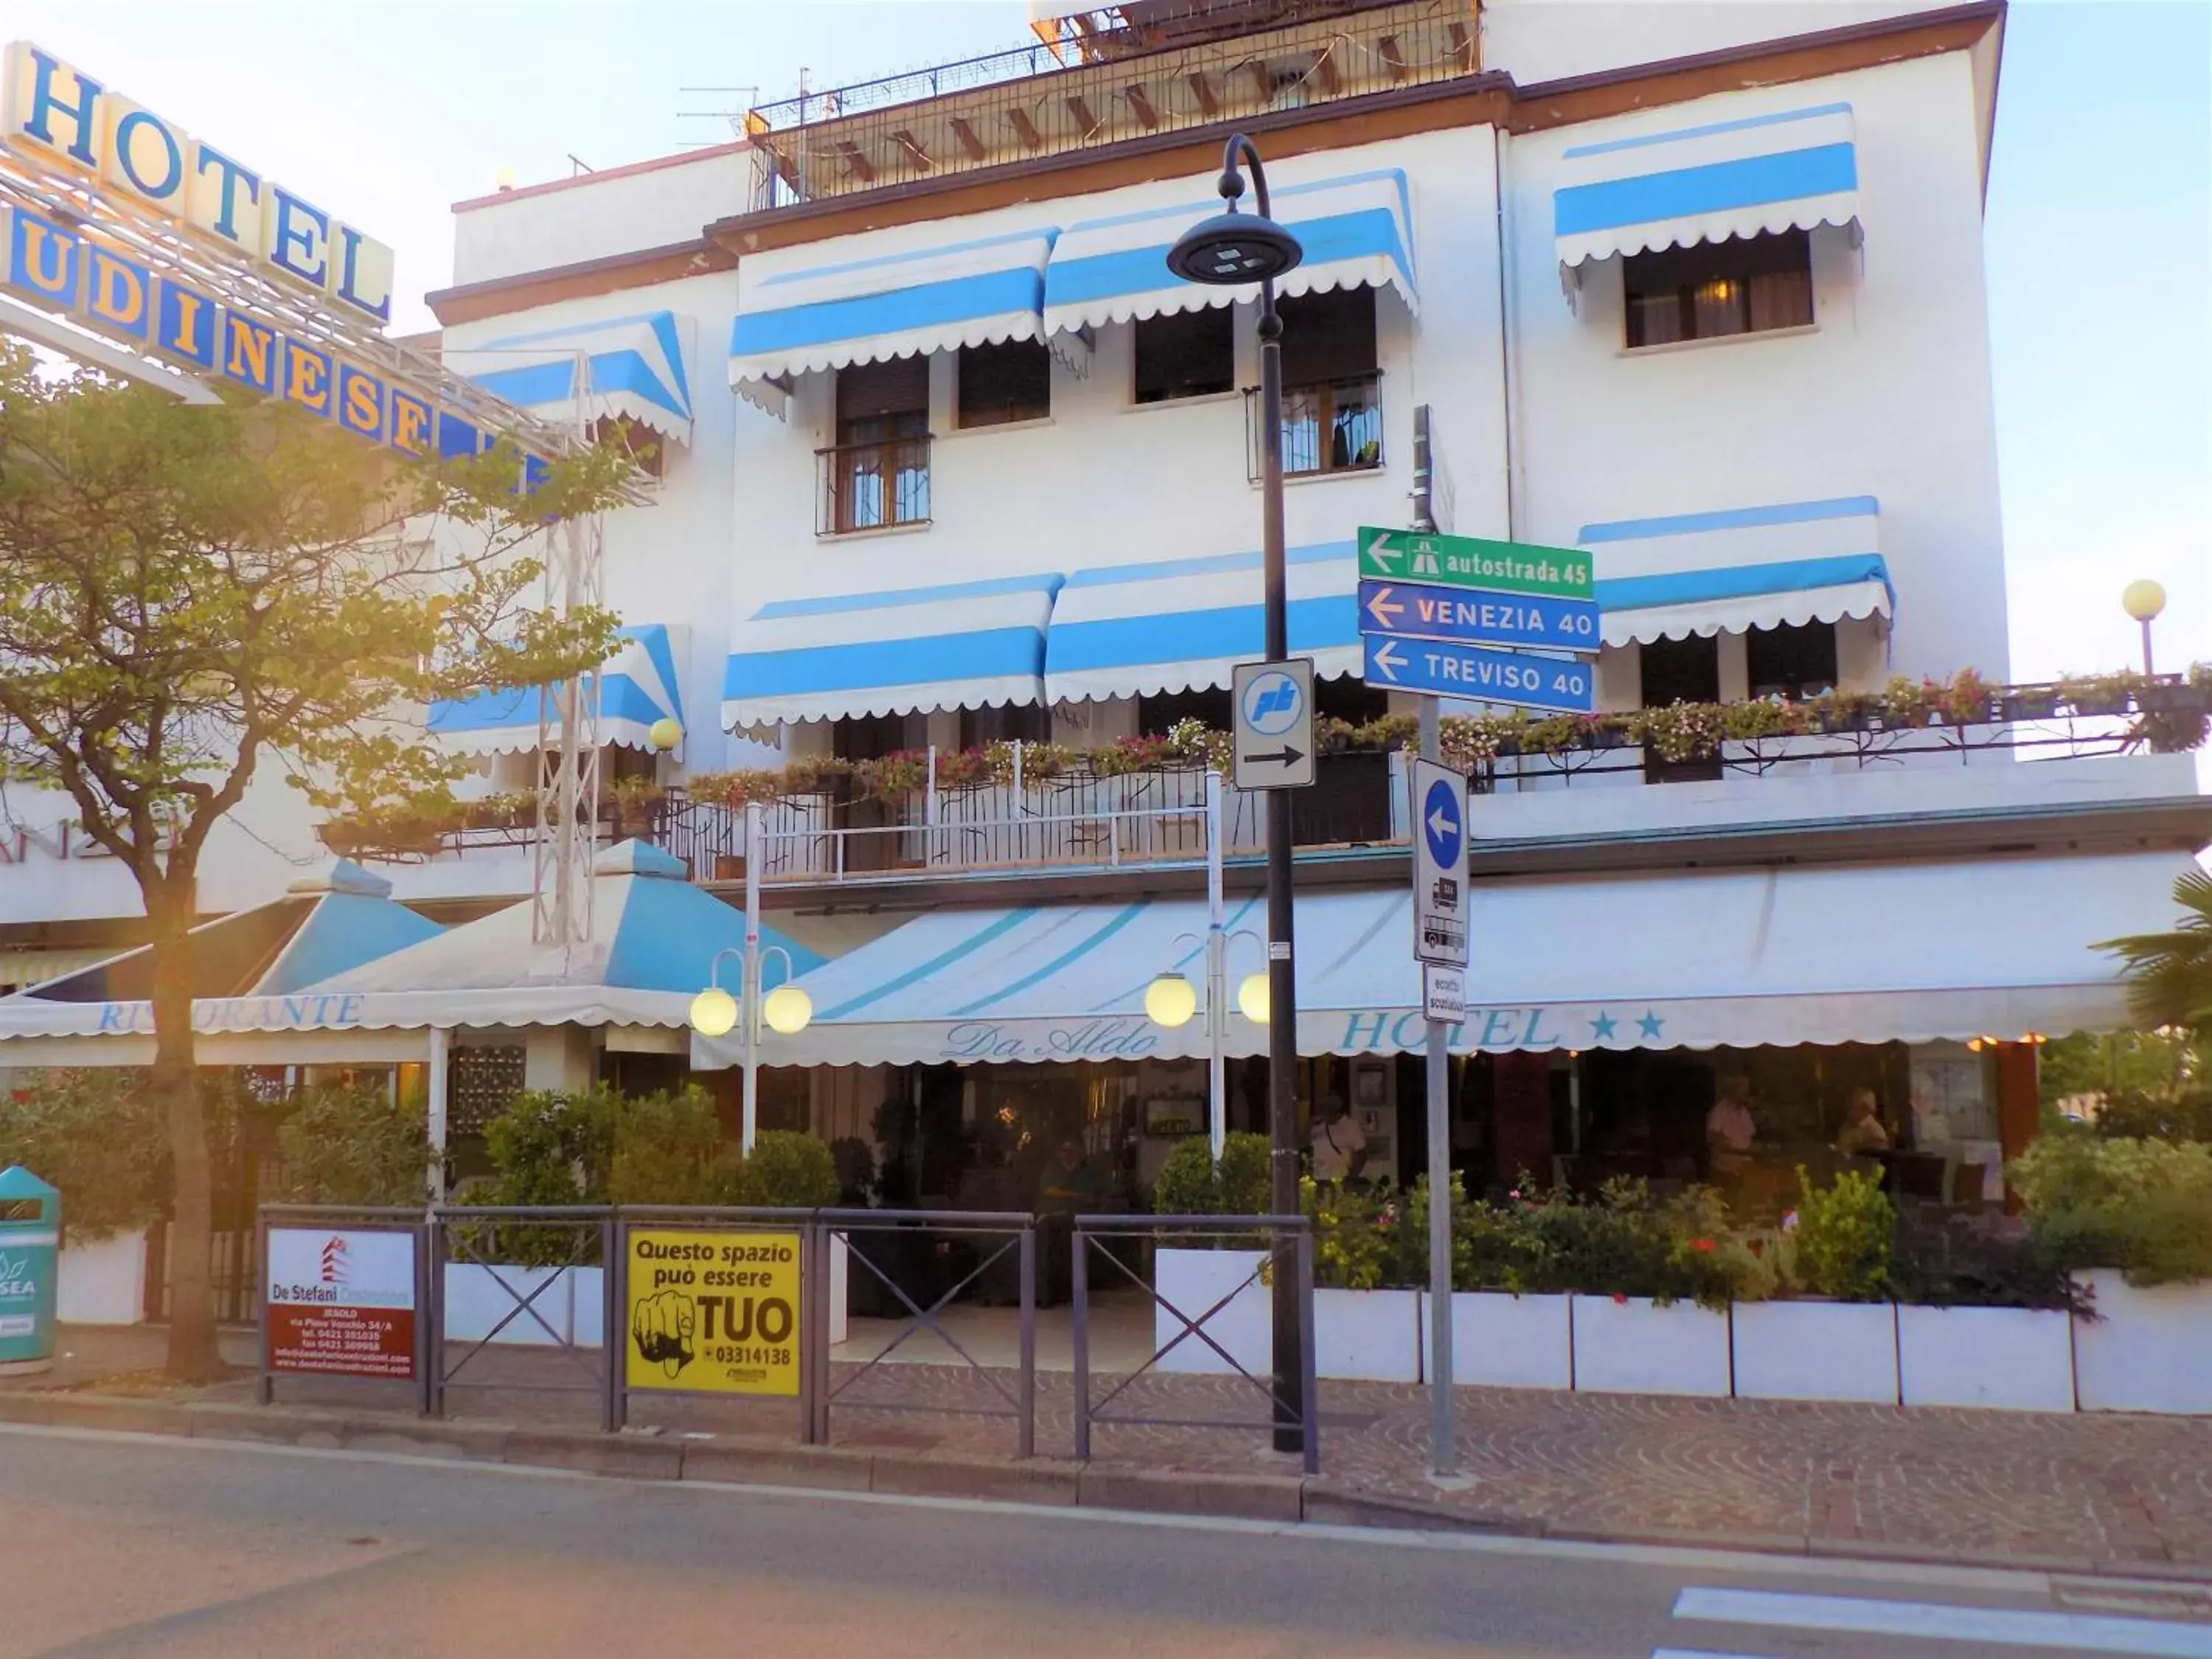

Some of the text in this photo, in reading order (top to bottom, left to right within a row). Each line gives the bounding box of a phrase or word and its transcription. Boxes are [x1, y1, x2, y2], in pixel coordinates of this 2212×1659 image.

[24, 48, 391, 326] HOTEL
[1447, 553, 1587, 585] autostrada 45
[1418, 599, 1592, 636] VENEZIA 40
[1425, 653, 1584, 696] TREVISO 40
[99, 993, 366, 1030] RIORANTE
[939, 1018, 1158, 1057] Da Aldo
[636, 1239, 792, 1267] Questo spazio
[274, 1284, 290, 1299] De
[292, 1284, 337, 1302] Stefani
[703, 1270, 772, 1287] essere
[697, 1295, 793, 1343] TUO
[716, 1346, 790, 1365] 03314138
